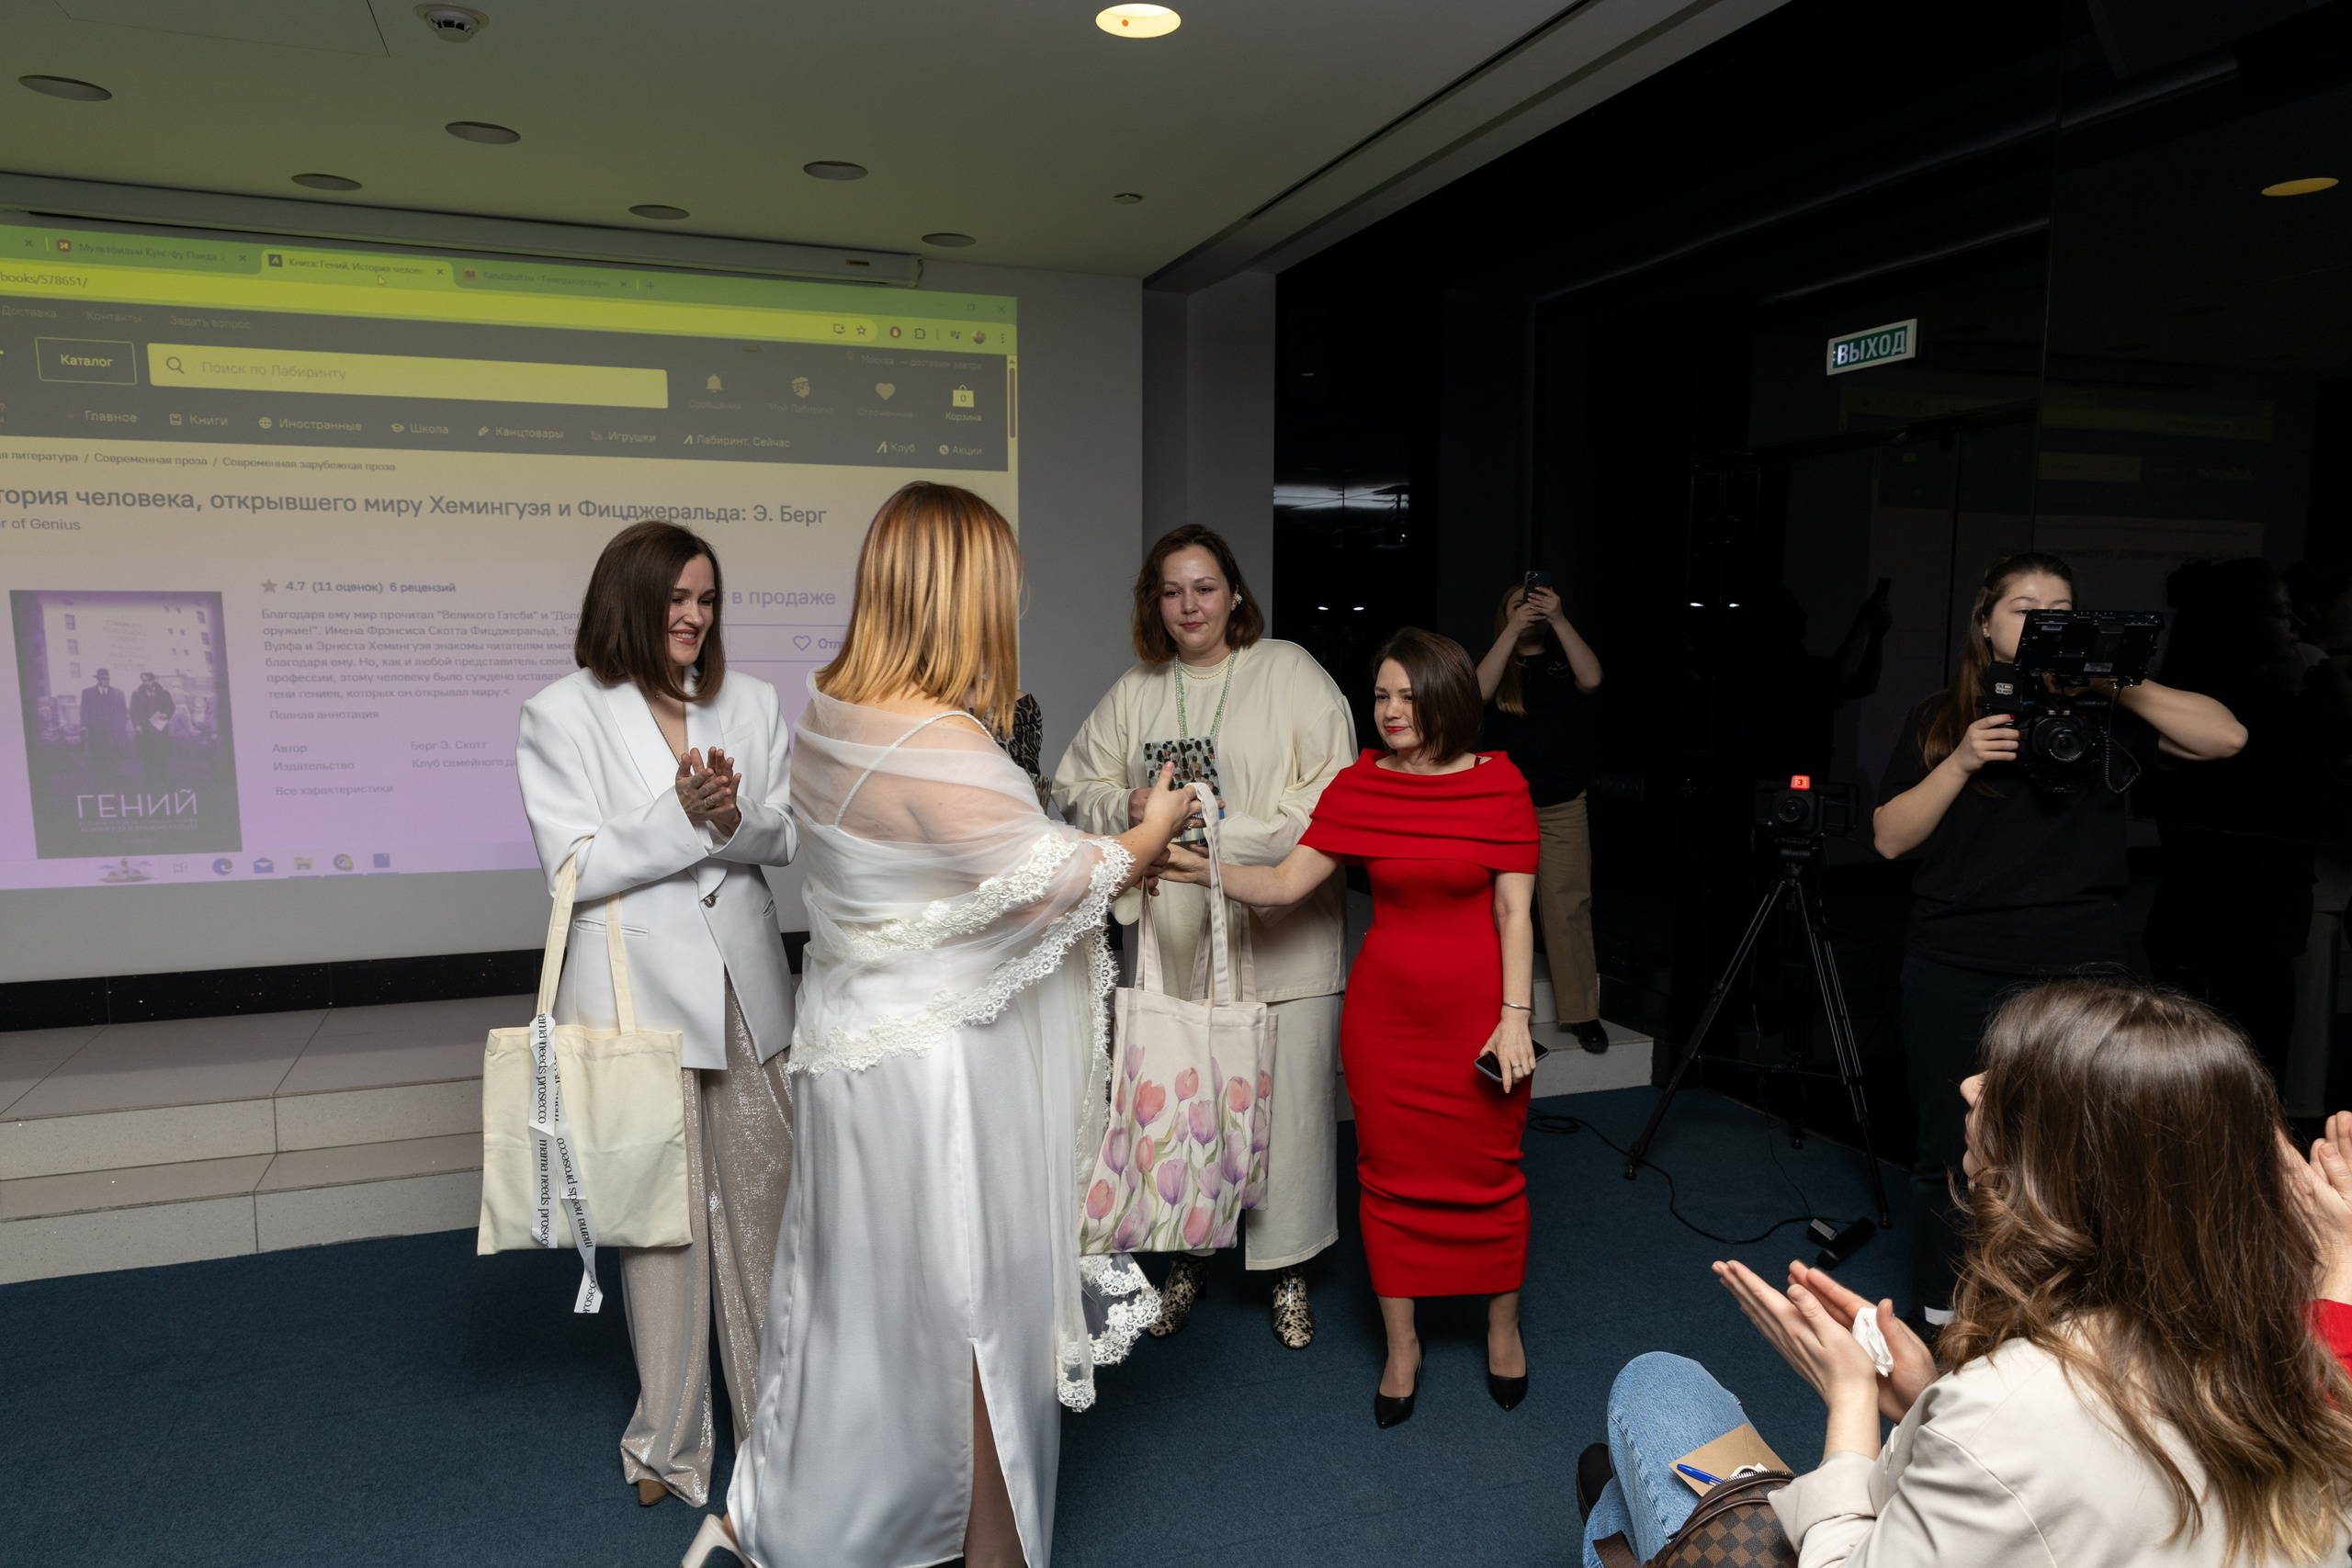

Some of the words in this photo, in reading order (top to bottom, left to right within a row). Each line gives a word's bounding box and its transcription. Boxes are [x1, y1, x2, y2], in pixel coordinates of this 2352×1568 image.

[288, 258, 318, 268] Книга:
[321, 260, 350, 270] Гений.
[353, 263, 390, 274] История
[2, 305, 57, 319] Доставка
[86, 310, 141, 323] Контакты
[170, 315, 209, 328] Задать
[211, 319, 250, 330] вопрос
[1837, 331, 1905, 366] ВЫХОД
[60, 354, 113, 367] Каталог
[202, 361, 247, 376] Поиск
[250, 367, 266, 377] по
[271, 365, 346, 381] Лабиринту
[85, 410, 137, 423] Главное
[789, 404, 834, 416] Лабиринт
[189, 415, 229, 427] Книги
[945, 411, 982, 423] Корзина
[278, 418, 362, 432] Иностранные
[410, 423, 448, 434] Школа
[495, 426, 564, 439] Канцтовары
[608, 431, 656, 443] Игрушки
[696, 434, 750, 446] Лабиринт.
[752, 436, 790, 448] Сейчас
[890, 442, 916, 455] Клуб
[952, 446, 982, 457] Акции
[12, 452, 78, 463] литература
[94, 453, 173, 465] Современная
[175, 457, 208, 468] проза
[222, 457, 297, 469] Современная
[300, 460, 363, 472] зарубежная
[365, 462, 396, 472] проза
[75, 491, 202, 512] человека,
[209, 494, 357, 514] открывшего
[365, 497, 423, 517] миру
[429, 495, 551, 521] Хемингуэя
[558, 502, 571, 517] и
[578, 500, 747, 522] Фицджеральда:
[752, 504, 775, 523] Э.
[780, 505, 828, 526] Берг
[11, 518, 26, 529] of
[29, 518, 81, 530] Genius
[286, 581, 305, 592] 4.7
[312, 581, 333, 594] (11
[335, 581, 383, 594] оценок)
[389, 581, 398, 592] 6
[400, 582, 457, 595] рецензий
[732, 591, 742, 604] в
[749, 591, 836, 608] продаже
[261, 609, 324, 622] Благодаря
[328, 612, 350, 622] ему
[354, 612, 377, 622] мир
[379, 611, 434, 622] прочитал
[436, 610, 495, 620] "Великого
[324, 626, 364, 636] Имена
[367, 626, 424, 637] Фрэнсиса
[428, 626, 468, 636] Скотта
[469, 626, 559, 637] Фицджеральда,
[265, 641, 302, 654] Вулфа
[305, 643, 313, 651] и
[315, 641, 366, 653] Эрнеста
[368, 641, 431, 654] Хемингуэя
[434, 643, 484, 651] знакомы
[487, 643, 544, 652] читателям
[265, 657, 328, 669] благодаря
[331, 659, 356, 670] ему.
[358, 658, 379, 669] Но,
[381, 659, 401, 667] как
[404, 659, 412, 667] и
[414, 657, 451, 667] любой
[455, 658, 537, 668] представитель
[539, 657, 572, 667] своей
[266, 673, 337, 685] профессии,
[340, 674, 374, 684] этому
[377, 673, 431, 684] человеку
[433, 671, 463, 682] было
[465, 672, 514, 684] суждено
[268, 691, 296, 699] тени
[299, 689, 343, 700] гениев,
[346, 689, 394, 699] которых
[397, 689, 413, 697] он
[414, 688, 469, 699] открывал
[269, 710, 314, 721] Полная
[317, 709, 379, 720] аннотация
[272, 744, 308, 755] Автор
[411, 740, 437, 751] Берг
[440, 740, 452, 750] Э.
[455, 739, 488, 750] Скотт
[273, 761, 355, 773] Издательство
[412, 758, 440, 770] Клуб
[443, 758, 503, 768] семейного
[276, 785, 297, 796] Все
[300, 784, 394, 797] характеристики
[76, 788, 198, 818] ГЕНИЙ
[538, 1041, 548, 1075] needs
[536, 1076, 547, 1124] prosecco
[539, 1139, 548, 1172] mama
[557, 1137, 578, 1185] prosecco
[540, 1174, 551, 1206] needs
[568, 1187, 583, 1215] needs
[577, 1217, 594, 1248] mama
